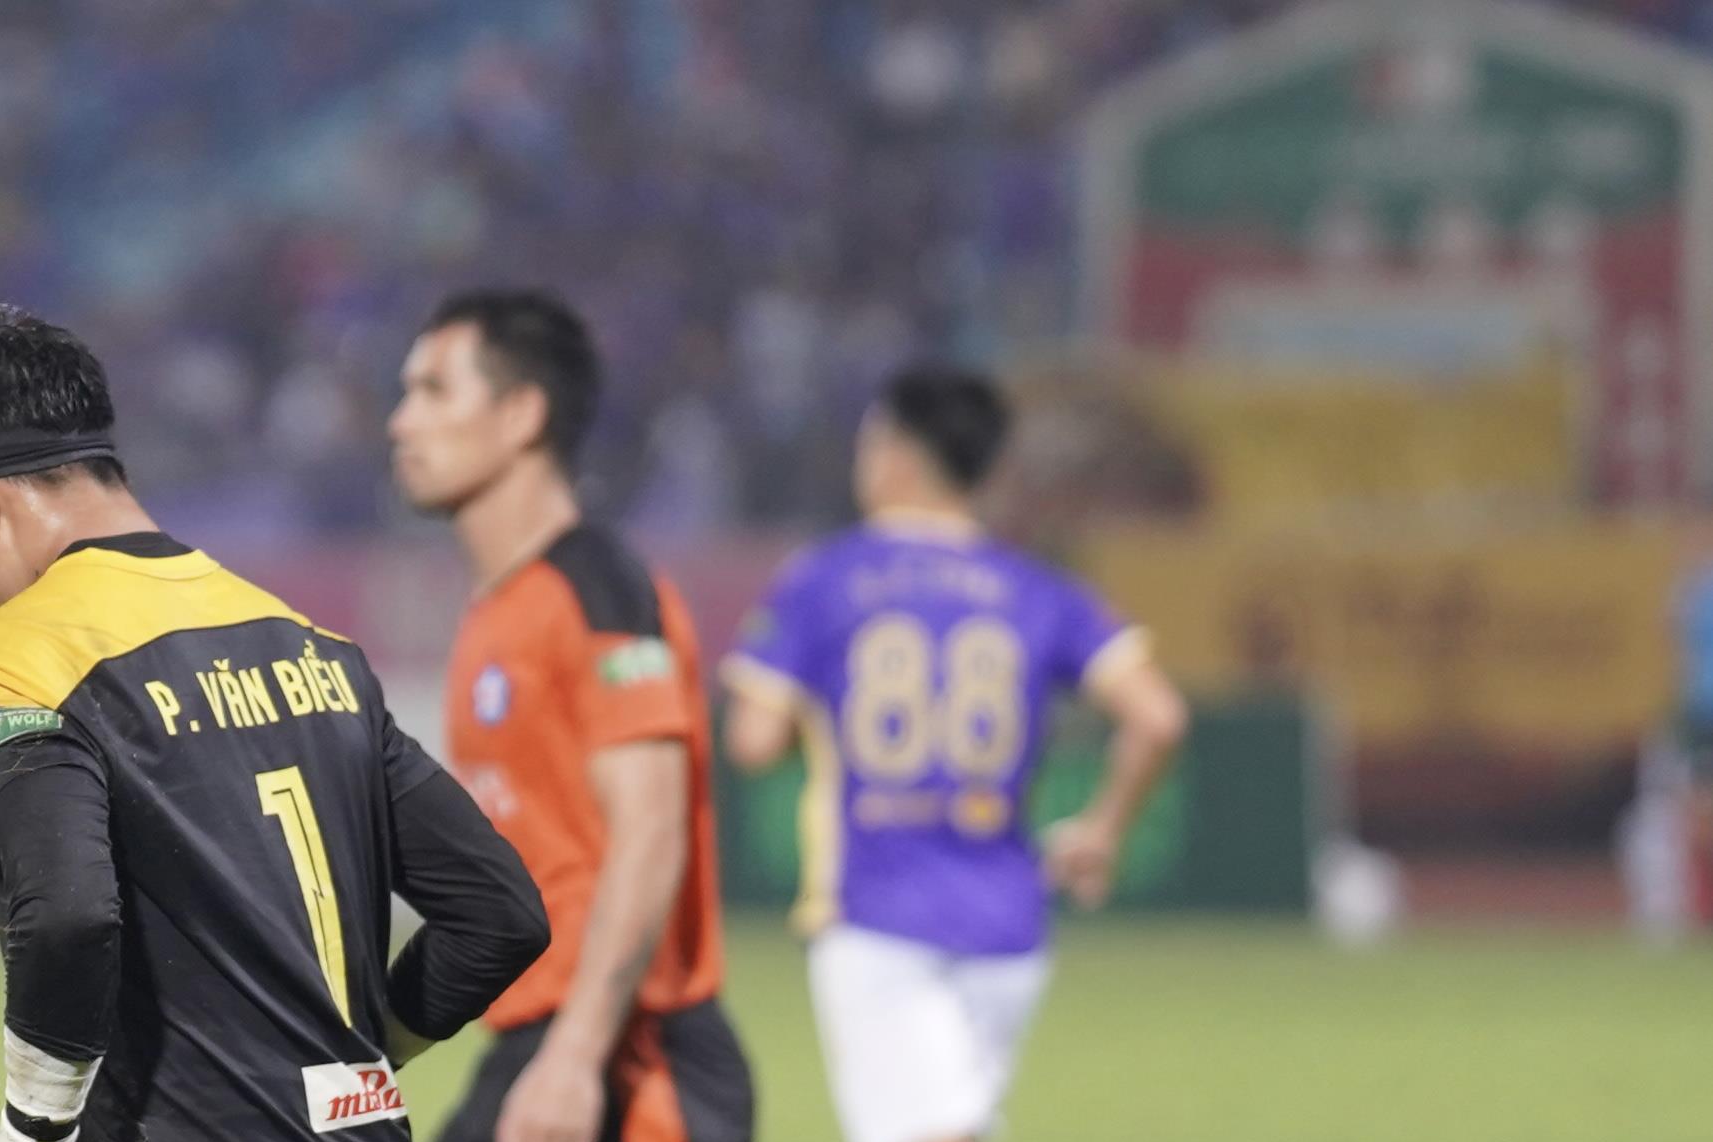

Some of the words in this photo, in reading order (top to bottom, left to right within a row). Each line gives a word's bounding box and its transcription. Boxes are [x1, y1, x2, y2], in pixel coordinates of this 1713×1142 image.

[7, 712, 54, 732] WOLF
[144, 680, 201, 736] P.
[196, 658, 280, 729] VĂN
[271, 639, 360, 717] BIỂU
[844, 611, 1028, 783] 88
[255, 765, 352, 1028] 1
